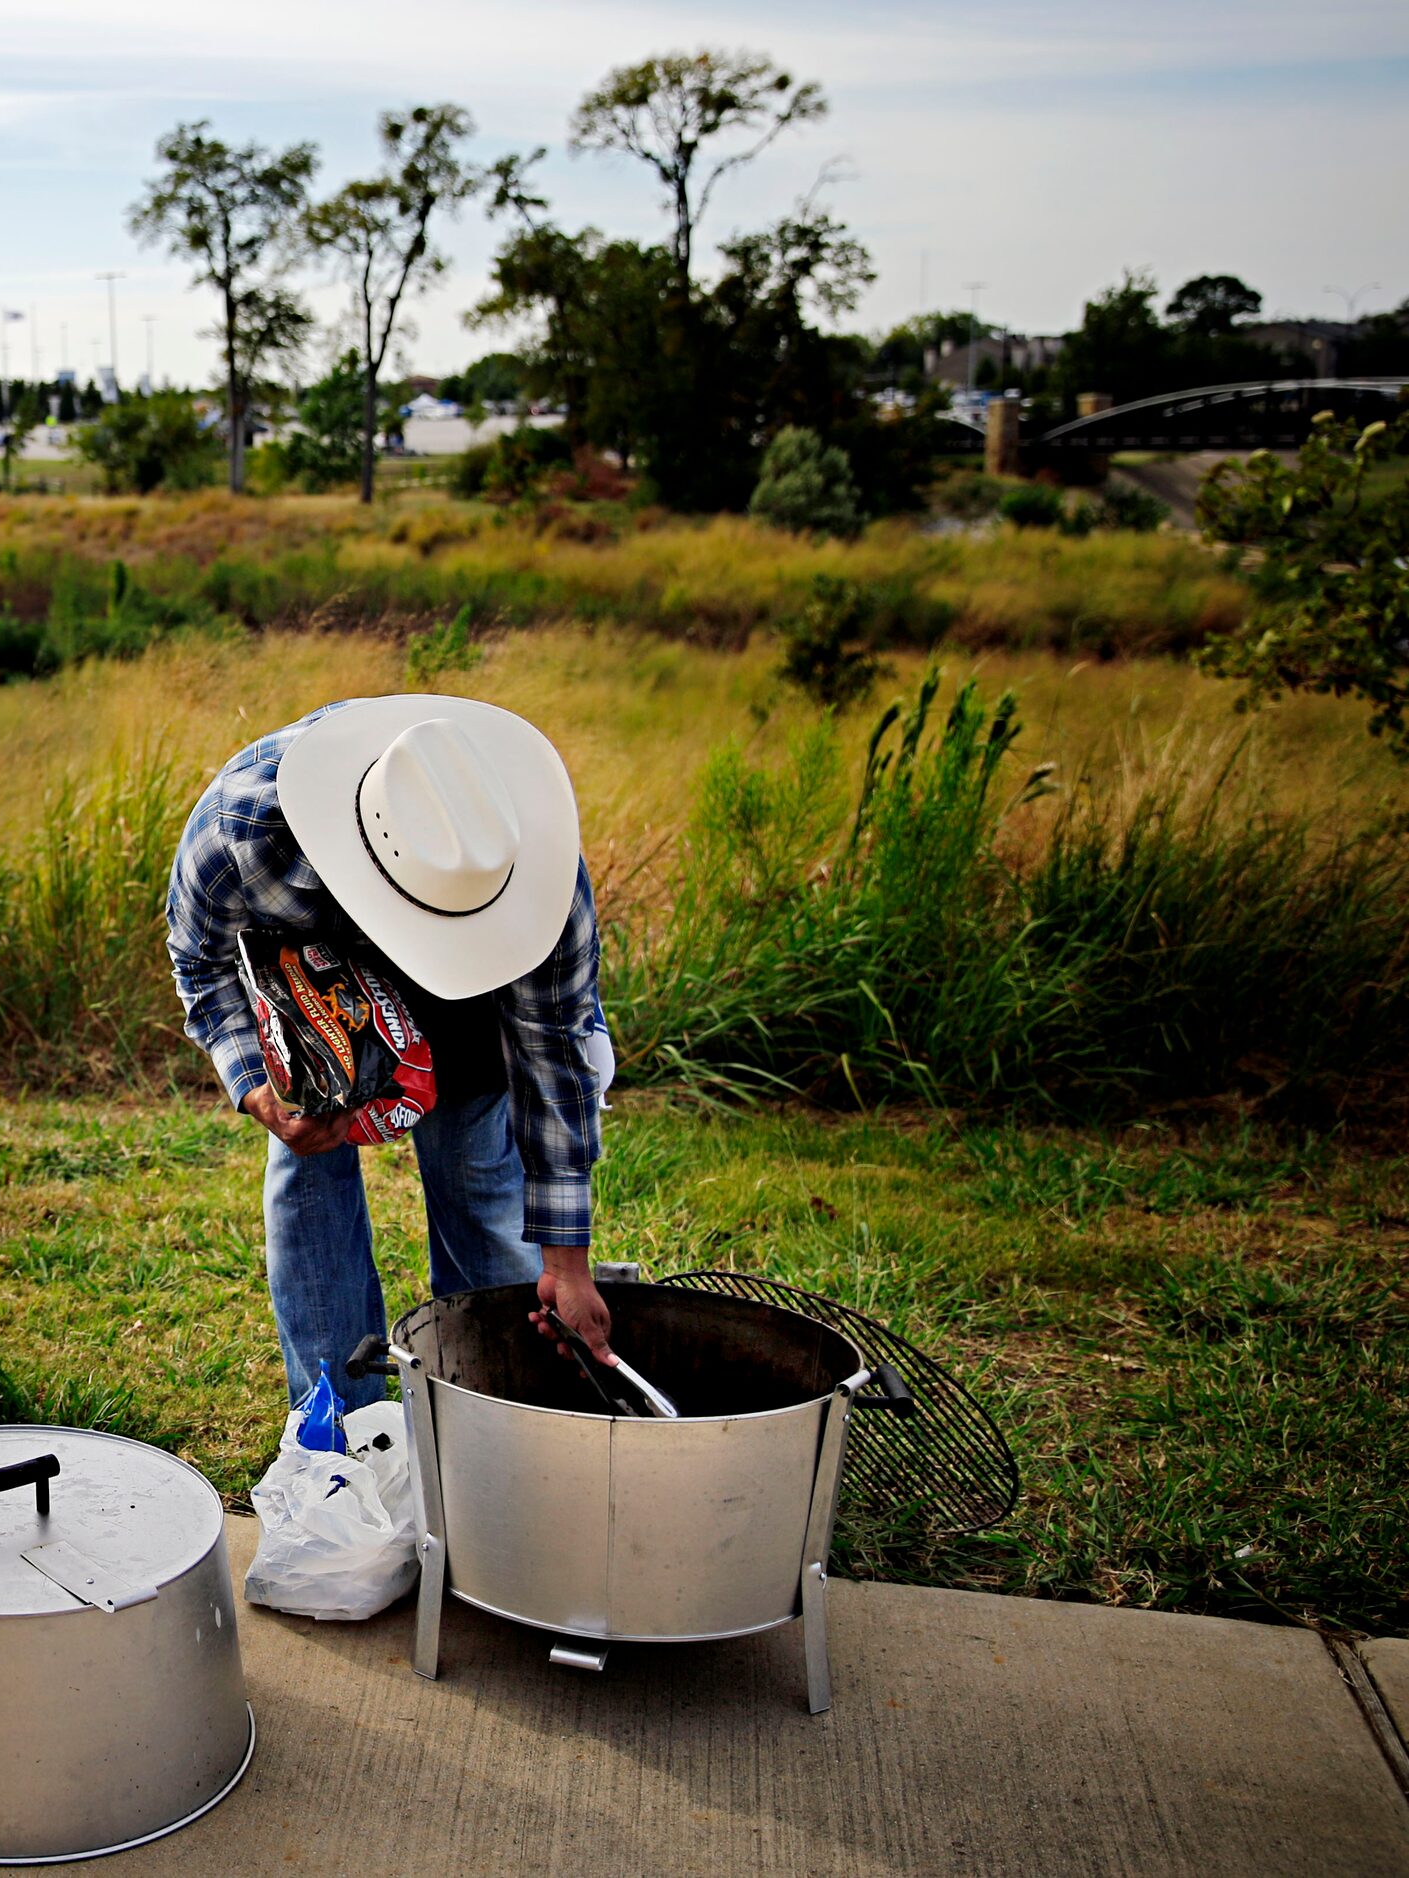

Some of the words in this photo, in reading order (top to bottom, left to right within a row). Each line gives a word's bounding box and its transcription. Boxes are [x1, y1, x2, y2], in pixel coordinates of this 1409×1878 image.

[283, 961, 307, 994] NEEDED
[299, 992, 322, 1019] FLUID
[315, 1017, 347, 1053] LIGHTER
